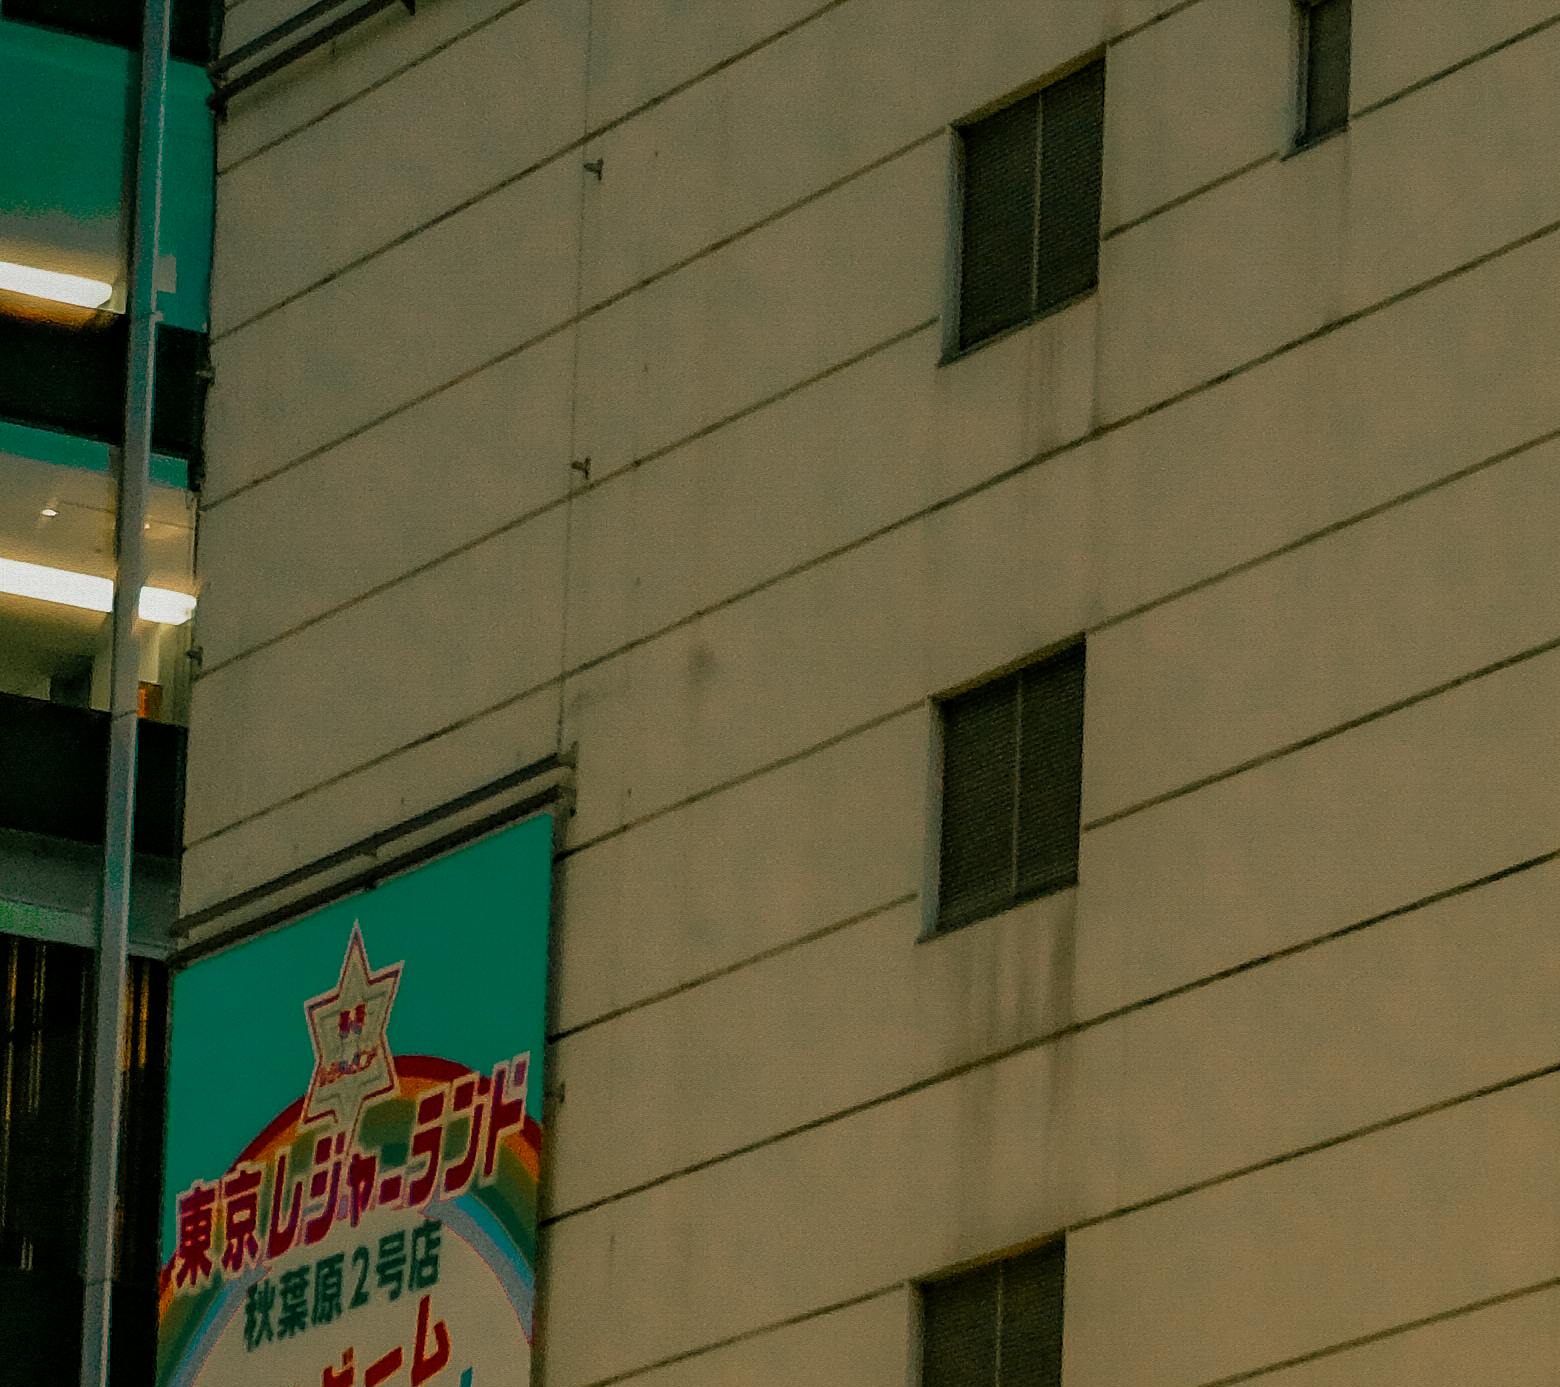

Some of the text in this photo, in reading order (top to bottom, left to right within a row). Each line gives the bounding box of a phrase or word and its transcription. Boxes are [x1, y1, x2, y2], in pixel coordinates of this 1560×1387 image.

[173, 1051, 532, 1290] 東京レジャーランド
[242, 1225, 443, 1353] 秋葉原2号店
